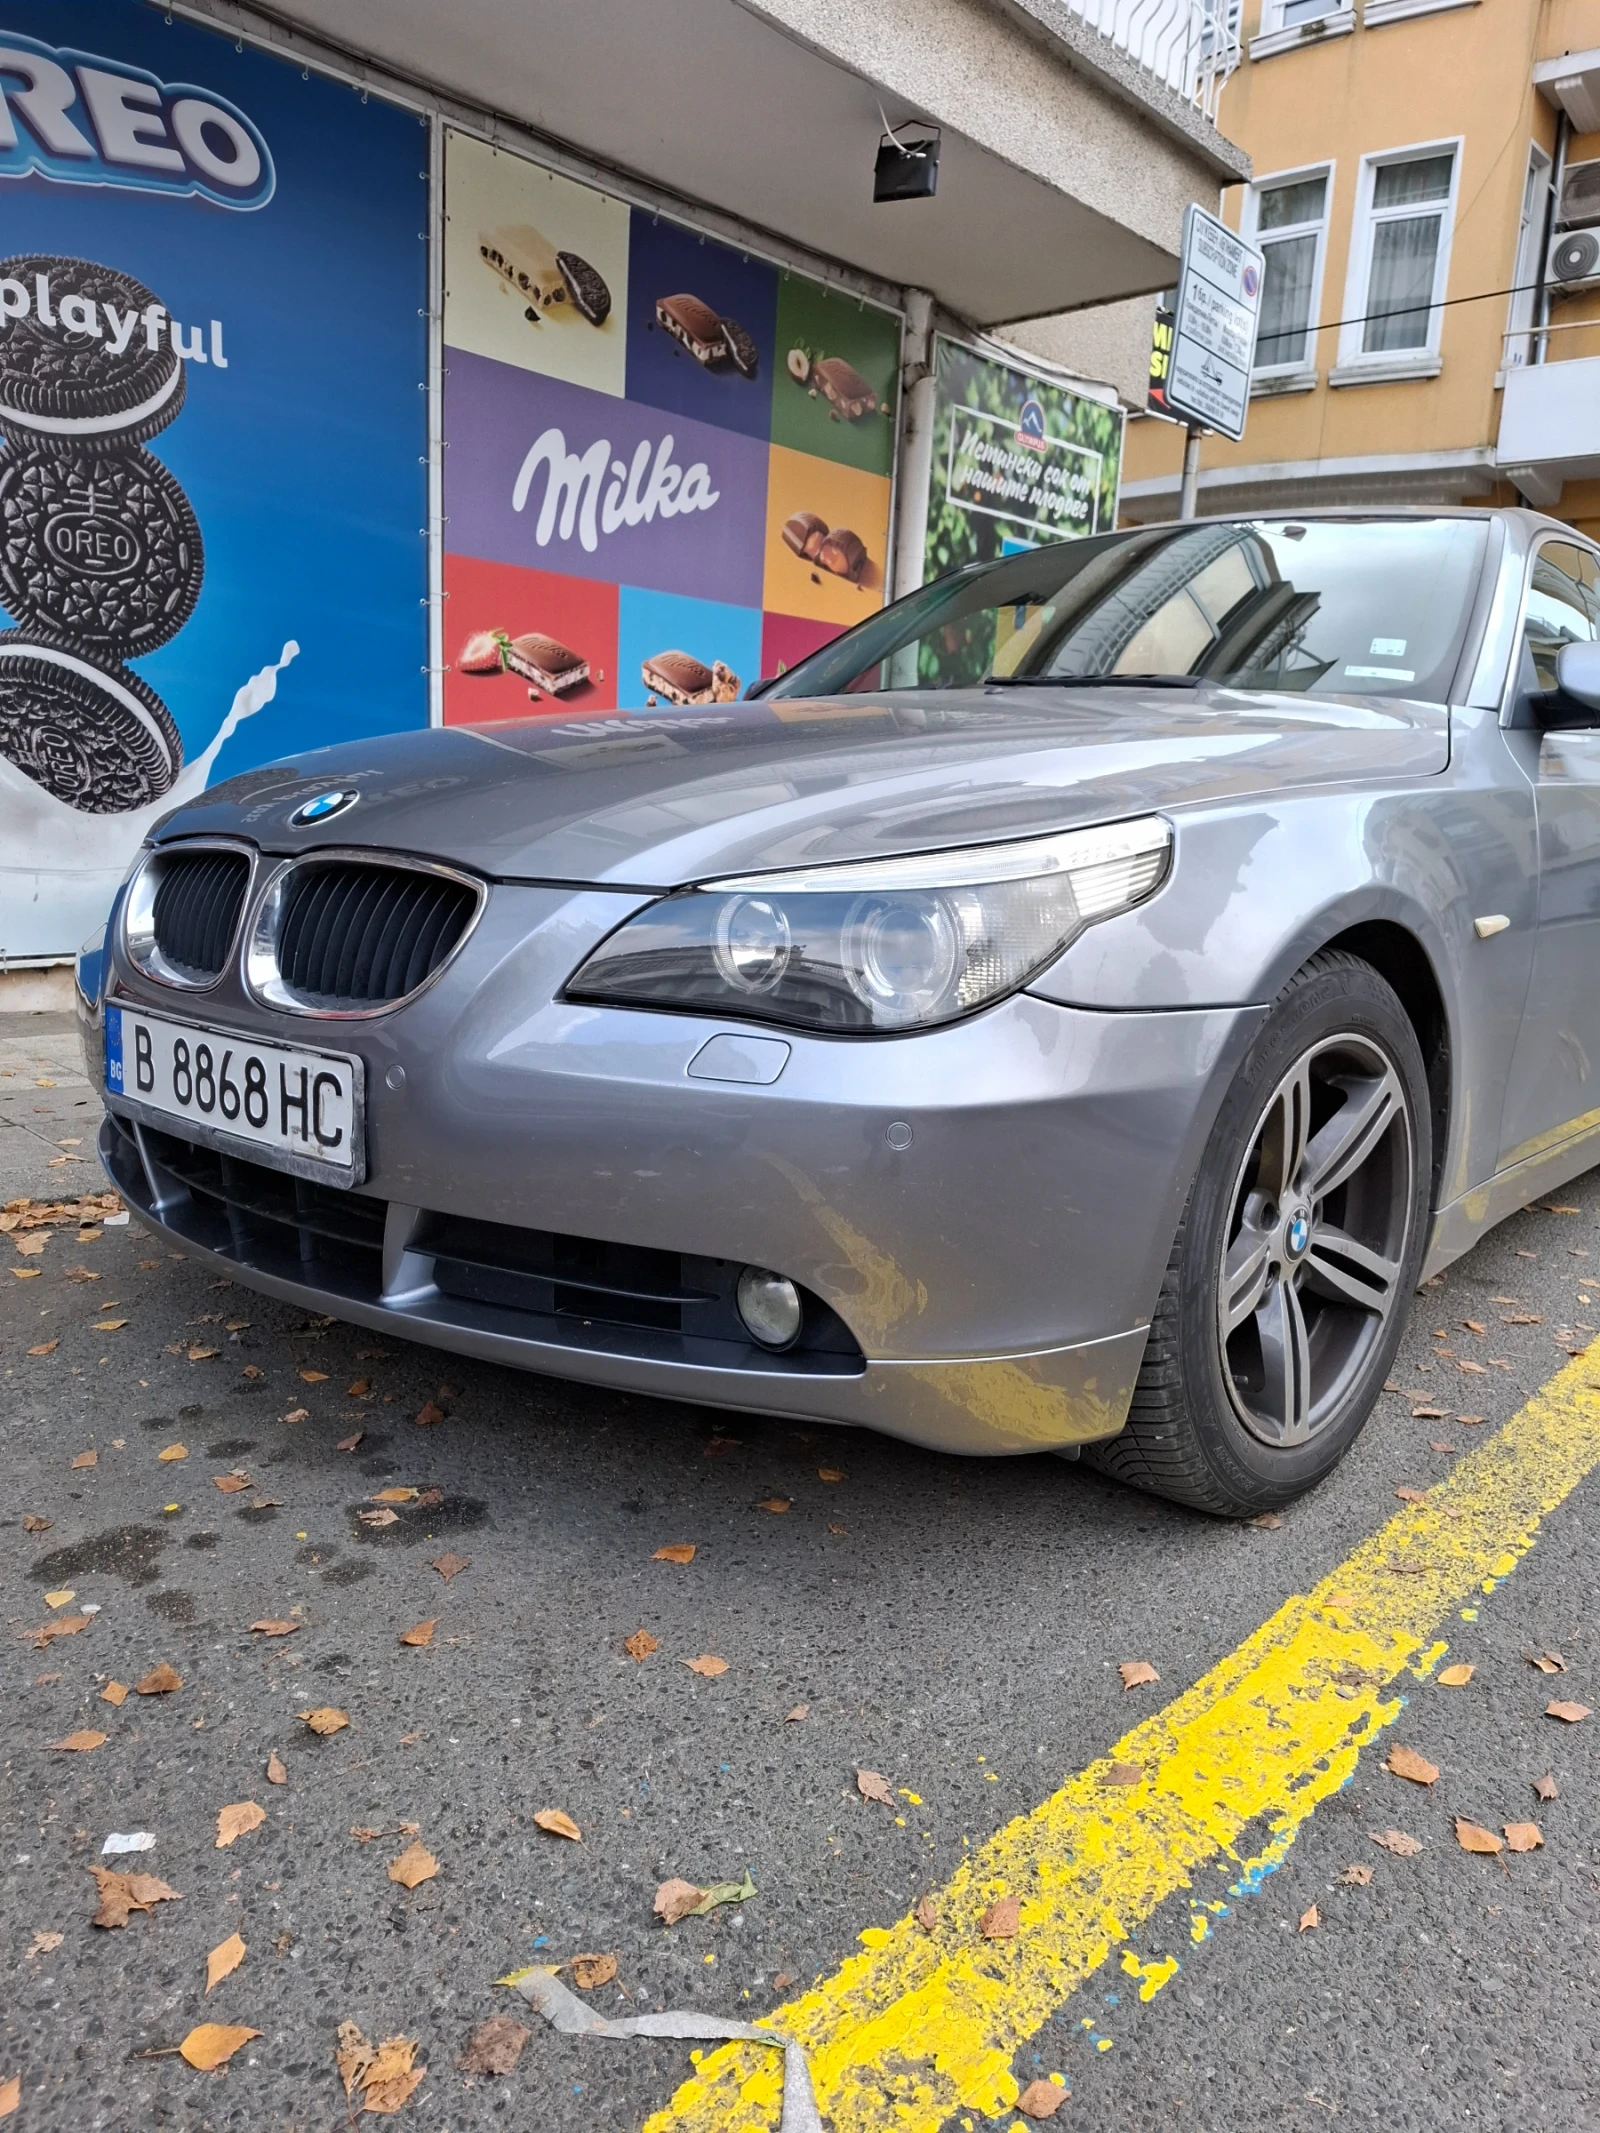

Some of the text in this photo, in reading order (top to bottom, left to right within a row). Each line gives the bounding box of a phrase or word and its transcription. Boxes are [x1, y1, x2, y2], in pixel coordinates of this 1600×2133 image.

[0, 273, 228, 368] playful
[511, 428, 721, 552] Milka
[960, 429, 1091, 496] Истински сок от
[963, 465, 1089, 520] нашите плодове
[56, 527, 130, 561] OREO
[42, 732, 79, 788] OREO
[109, 1059, 123, 1081] BG
[134, 1024, 344, 1148] B 8868 HC
